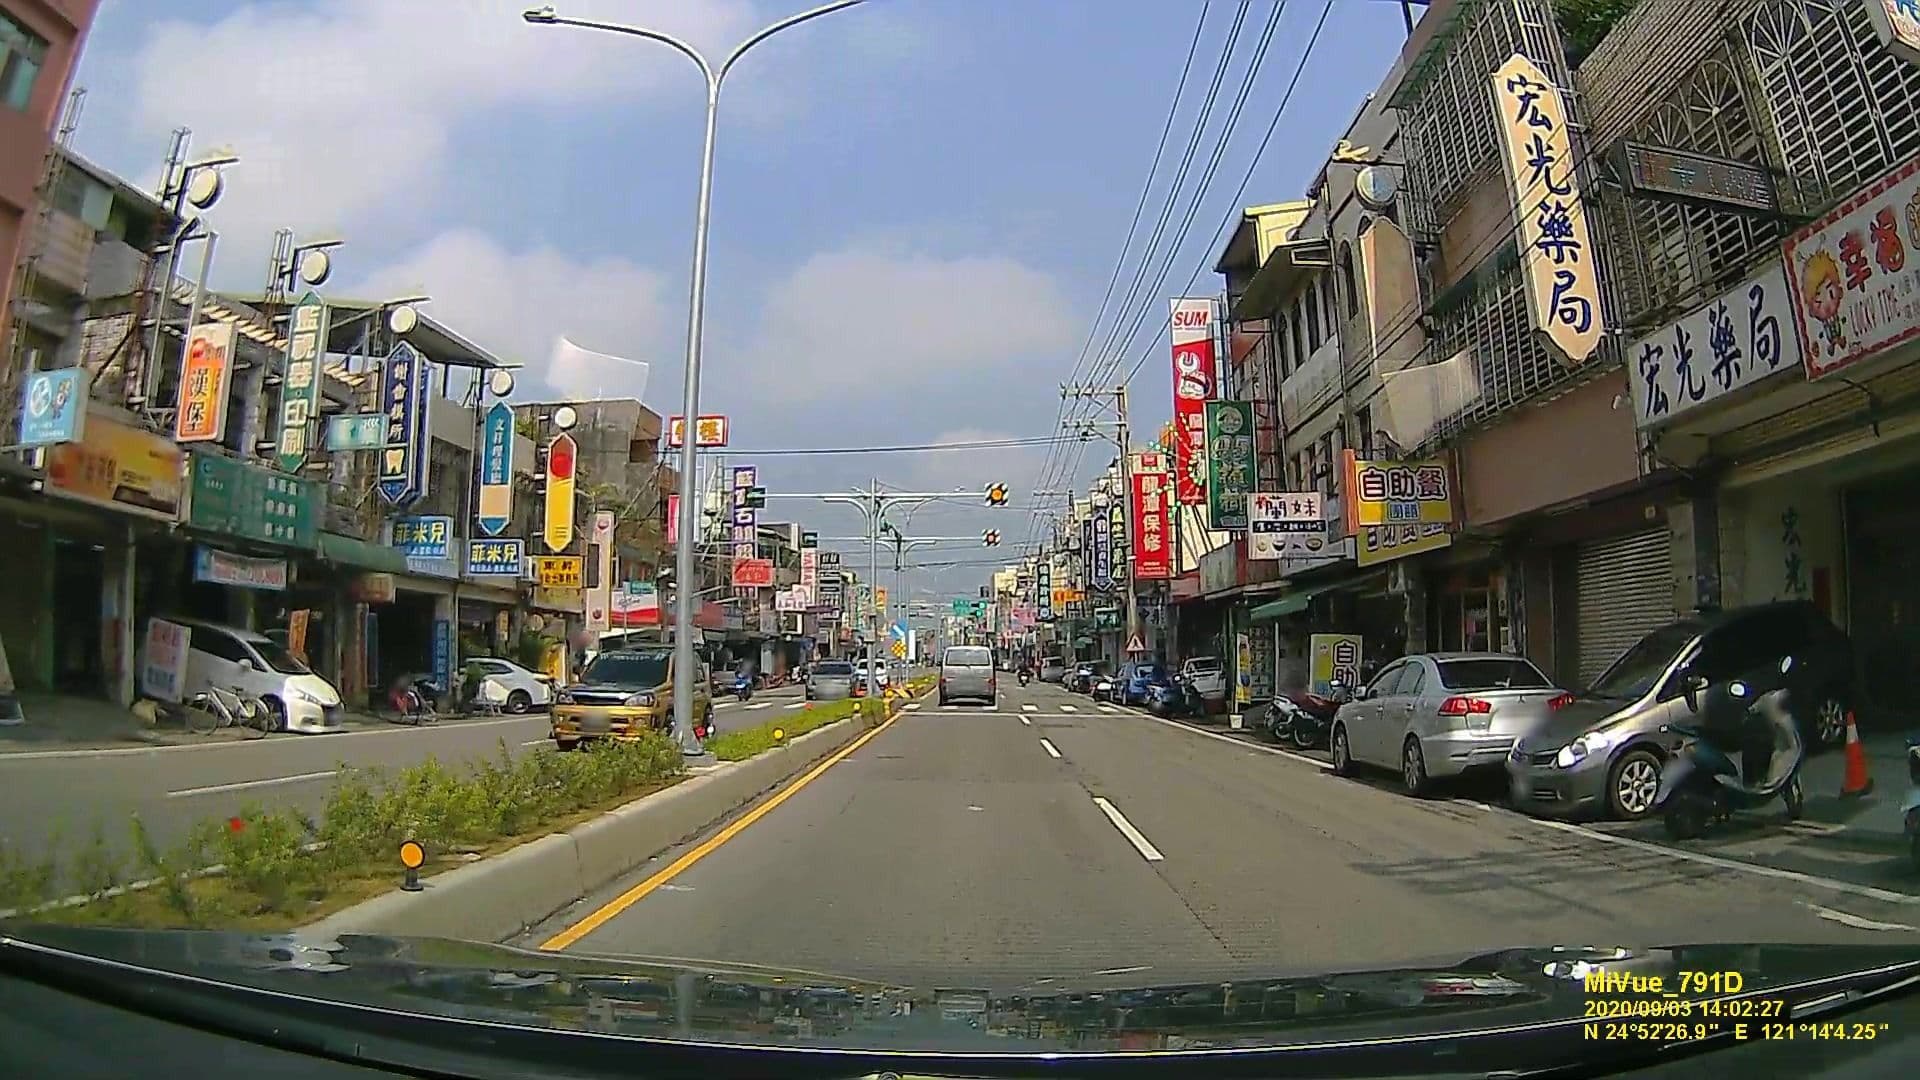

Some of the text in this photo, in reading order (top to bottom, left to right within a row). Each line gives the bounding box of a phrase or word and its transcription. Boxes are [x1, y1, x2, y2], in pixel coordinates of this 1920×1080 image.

[1506, 74, 1592, 333] 宏光藥局
[1173, 311, 1208, 327] SUM
[1639, 284, 1781, 418] 宏光藥局
[1361, 466, 1445, 499] 自助餐
